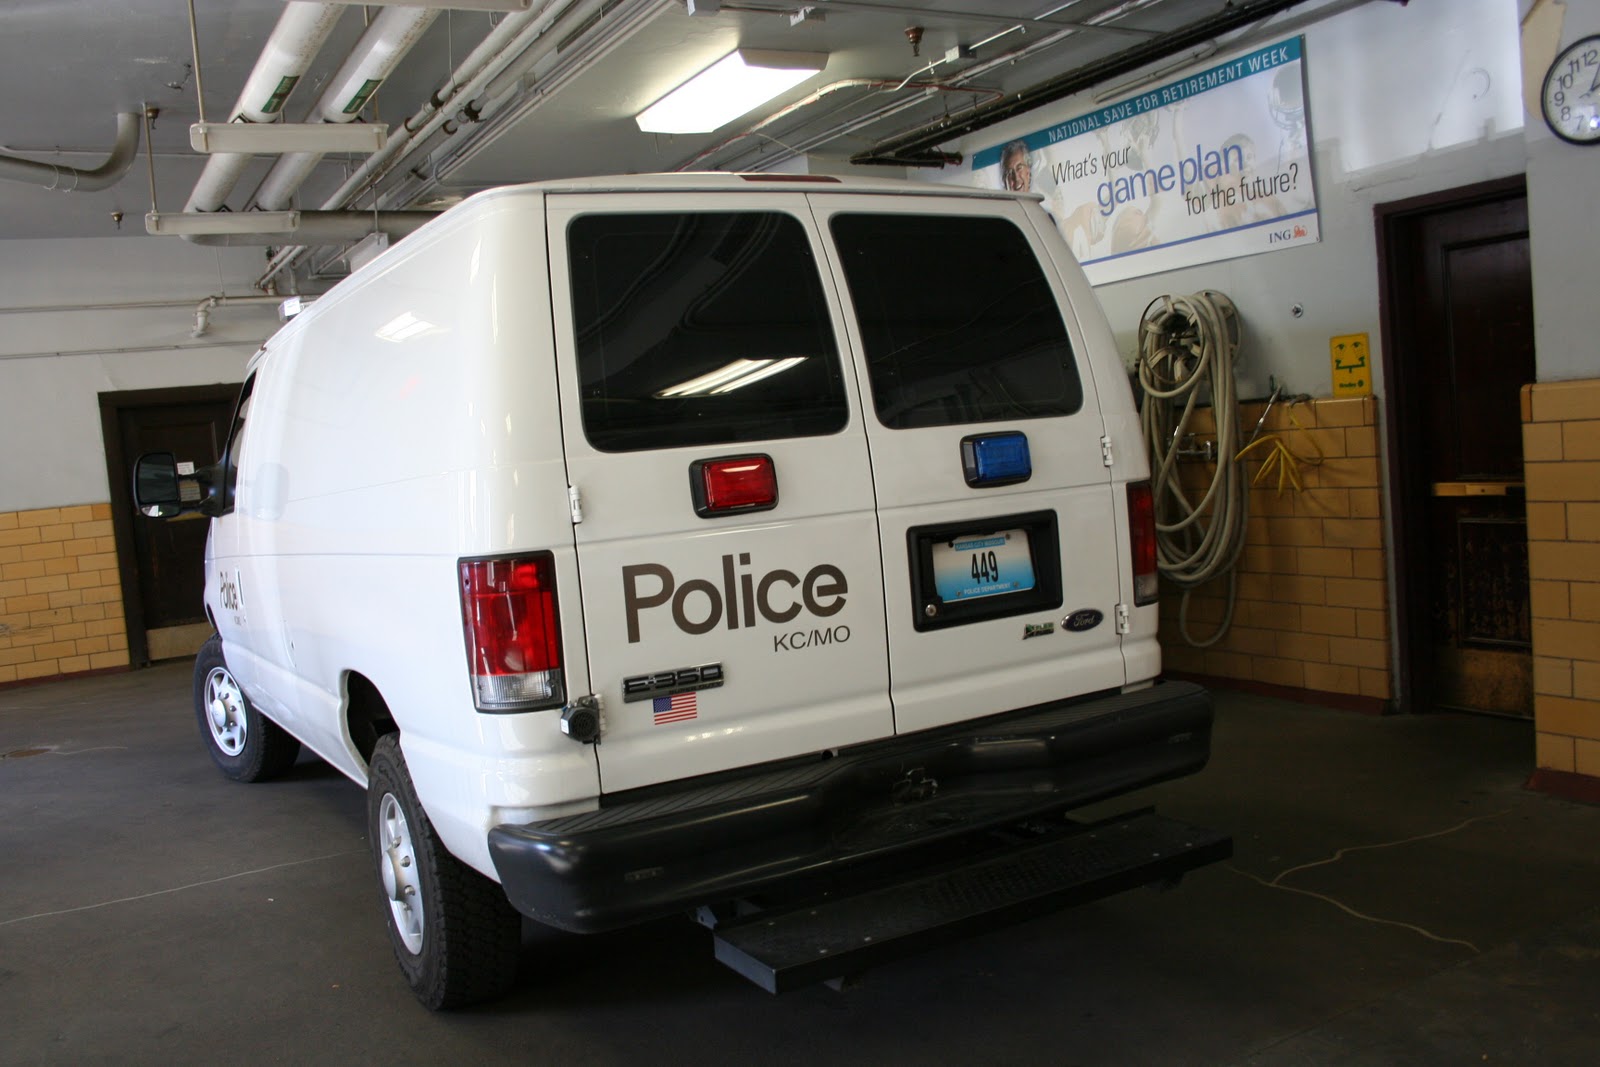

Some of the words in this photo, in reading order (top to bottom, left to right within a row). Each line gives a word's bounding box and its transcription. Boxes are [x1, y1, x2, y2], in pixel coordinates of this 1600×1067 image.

[1048, 115, 1101, 143] NATIONAL
[1104, 103, 1133, 124] SAVE
[1136, 93, 1159, 113] FOR
[1162, 62, 1244, 103] RETIREMENT
[1248, 46, 1289, 73] WEEK
[1051, 153, 1098, 185] What's
[1101, 146, 1132, 175] your
[1185, 191, 1208, 216] for
[1210, 185, 1236, 210] the
[1240, 163, 1299, 203] future?
[1269, 229, 1291, 243] ING
[971, 551, 999, 585] 449
[220, 571, 238, 611] Police
[622, 552, 848, 644] Police
[964, 586, 981, 595] POLICE
[981, 582, 1011, 594] DEPARTMENT
[1073, 613, 1096, 627] Ford
[773, 625, 851, 652] KC/MO
[624, 664, 723, 694] E-350
